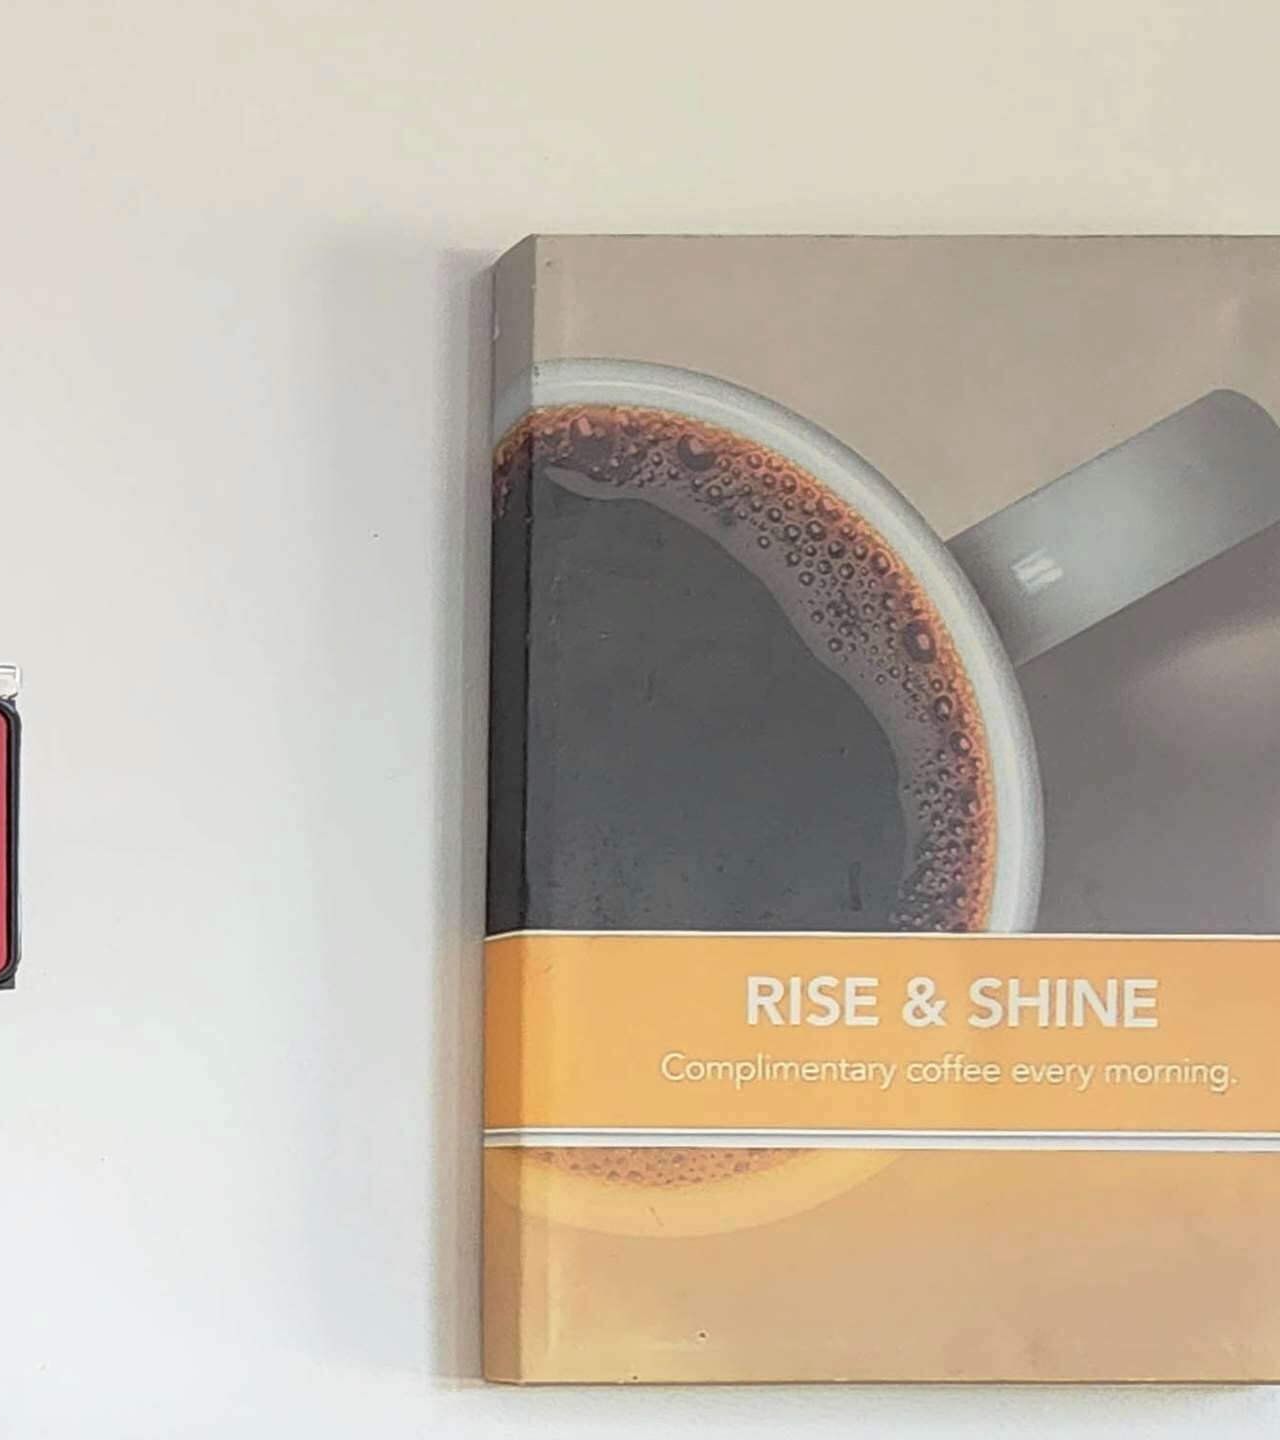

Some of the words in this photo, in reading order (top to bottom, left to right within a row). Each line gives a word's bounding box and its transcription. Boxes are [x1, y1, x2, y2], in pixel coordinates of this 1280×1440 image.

[746, 975, 878, 1026] RISE
[901, 975, 947, 1028] &
[967, 977, 1159, 1029] SHINE
[661, 1053, 896, 1091] Complimentary
[905, 1053, 1000, 1084] coffee
[1011, 1060, 1093, 1092] every
[1105, 1056, 1238, 1096] morning.
